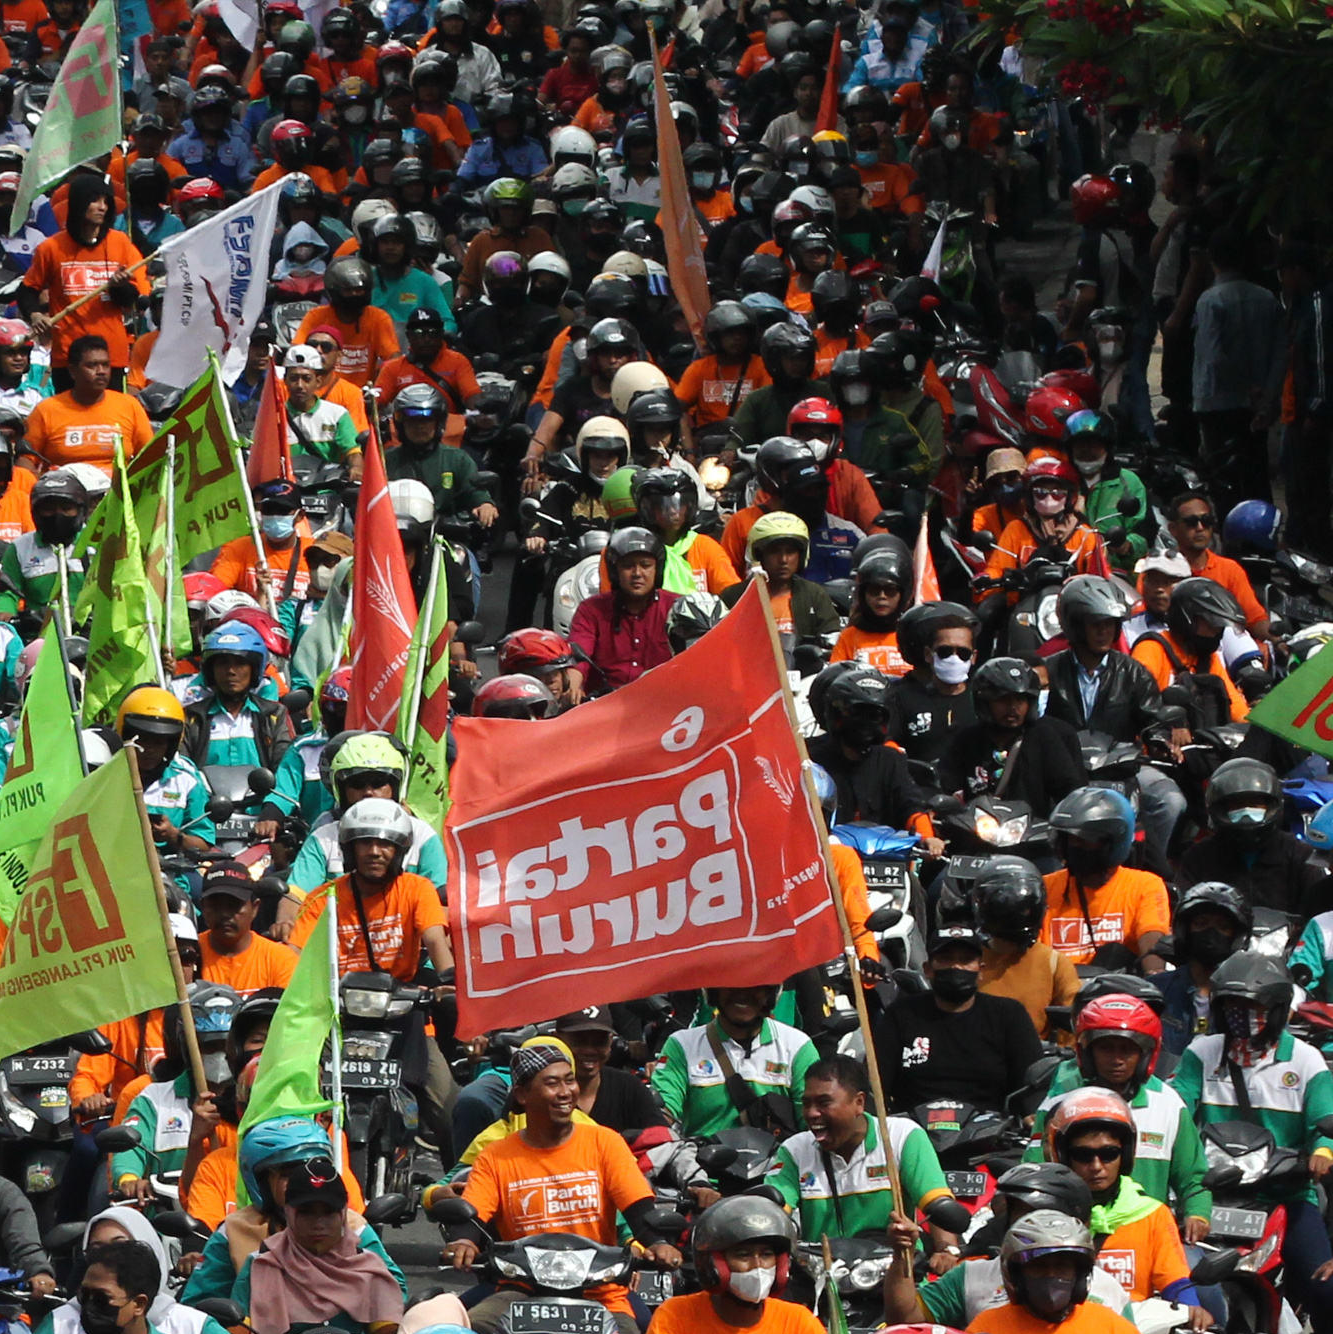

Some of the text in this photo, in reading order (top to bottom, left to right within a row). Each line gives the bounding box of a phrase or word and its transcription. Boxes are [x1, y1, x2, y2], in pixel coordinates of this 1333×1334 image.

[69, 431, 82, 447] 6
[32, 1058, 67, 1071] 4332
[546, 1185, 599, 1203] Partai
[546, 1197, 599, 1214] Buruh
[512, 1303, 604, 1323] W 5631 YZ
